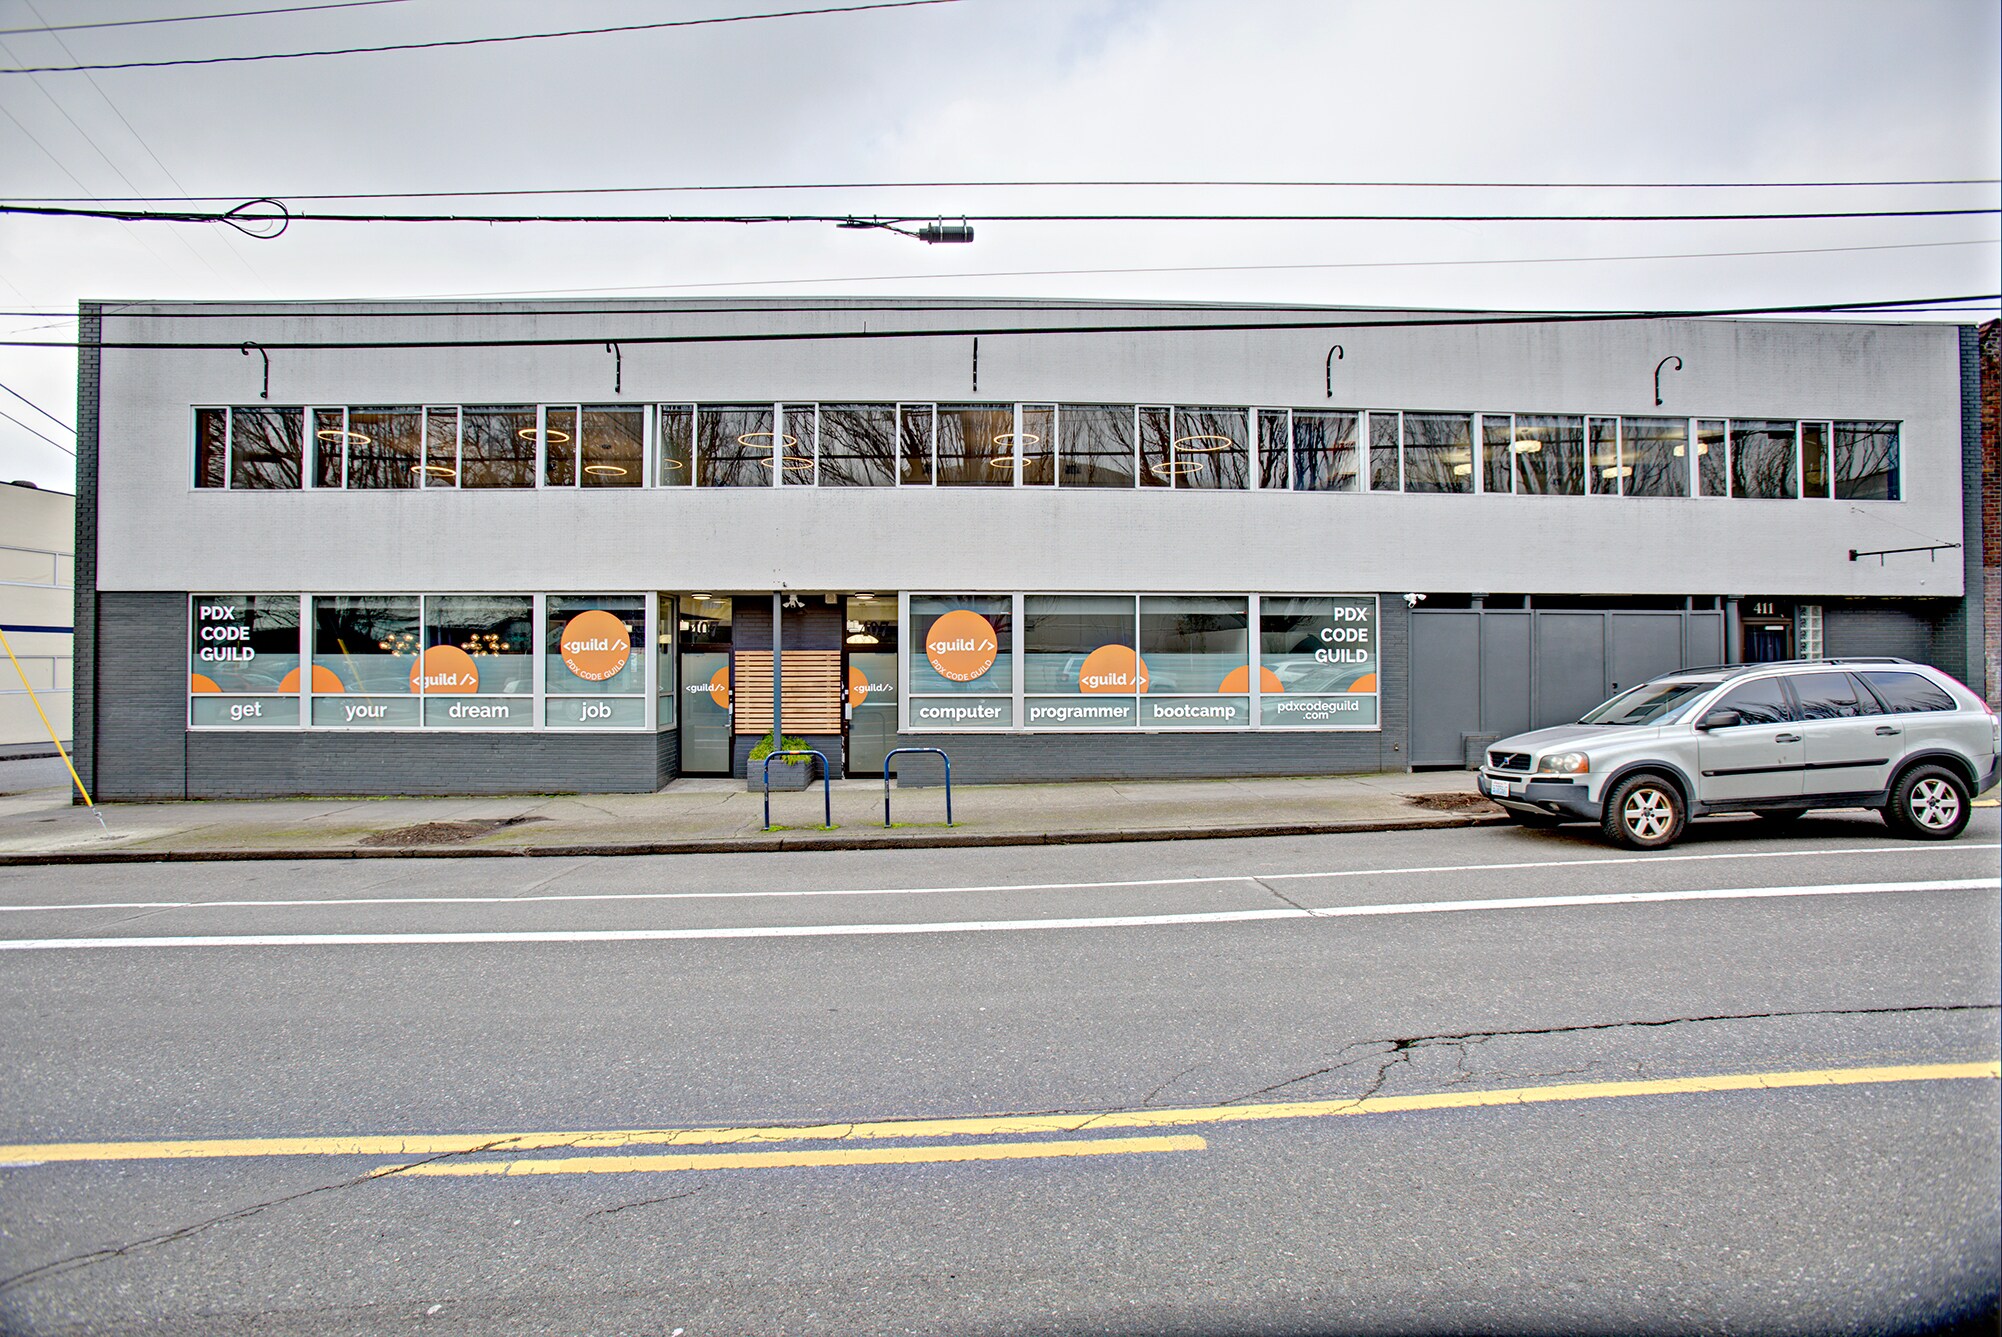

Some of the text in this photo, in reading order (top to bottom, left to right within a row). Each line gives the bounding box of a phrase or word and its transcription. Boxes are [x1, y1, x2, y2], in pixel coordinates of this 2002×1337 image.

[200, 606, 235, 620] PDX
[1334, 607, 1368, 622] PDX
[1753, 602, 1774, 615] 411
[200, 626, 250, 641] CODE
[1320, 627, 1369, 643] CODE
[200, 647, 255, 661] GUILD
[1315, 648, 1368, 663] GUILD
[566, 658, 625, 681] PDX CODE GUILD
[931, 659, 993, 681] PDX CODE GUILD
[230, 701, 612, 722] get your dream job
[919, 704, 1236, 722] computer programmer bootcamp
[1277, 700, 1360, 715] pdxcodeguild
[1302, 711, 1330, 720] .com
